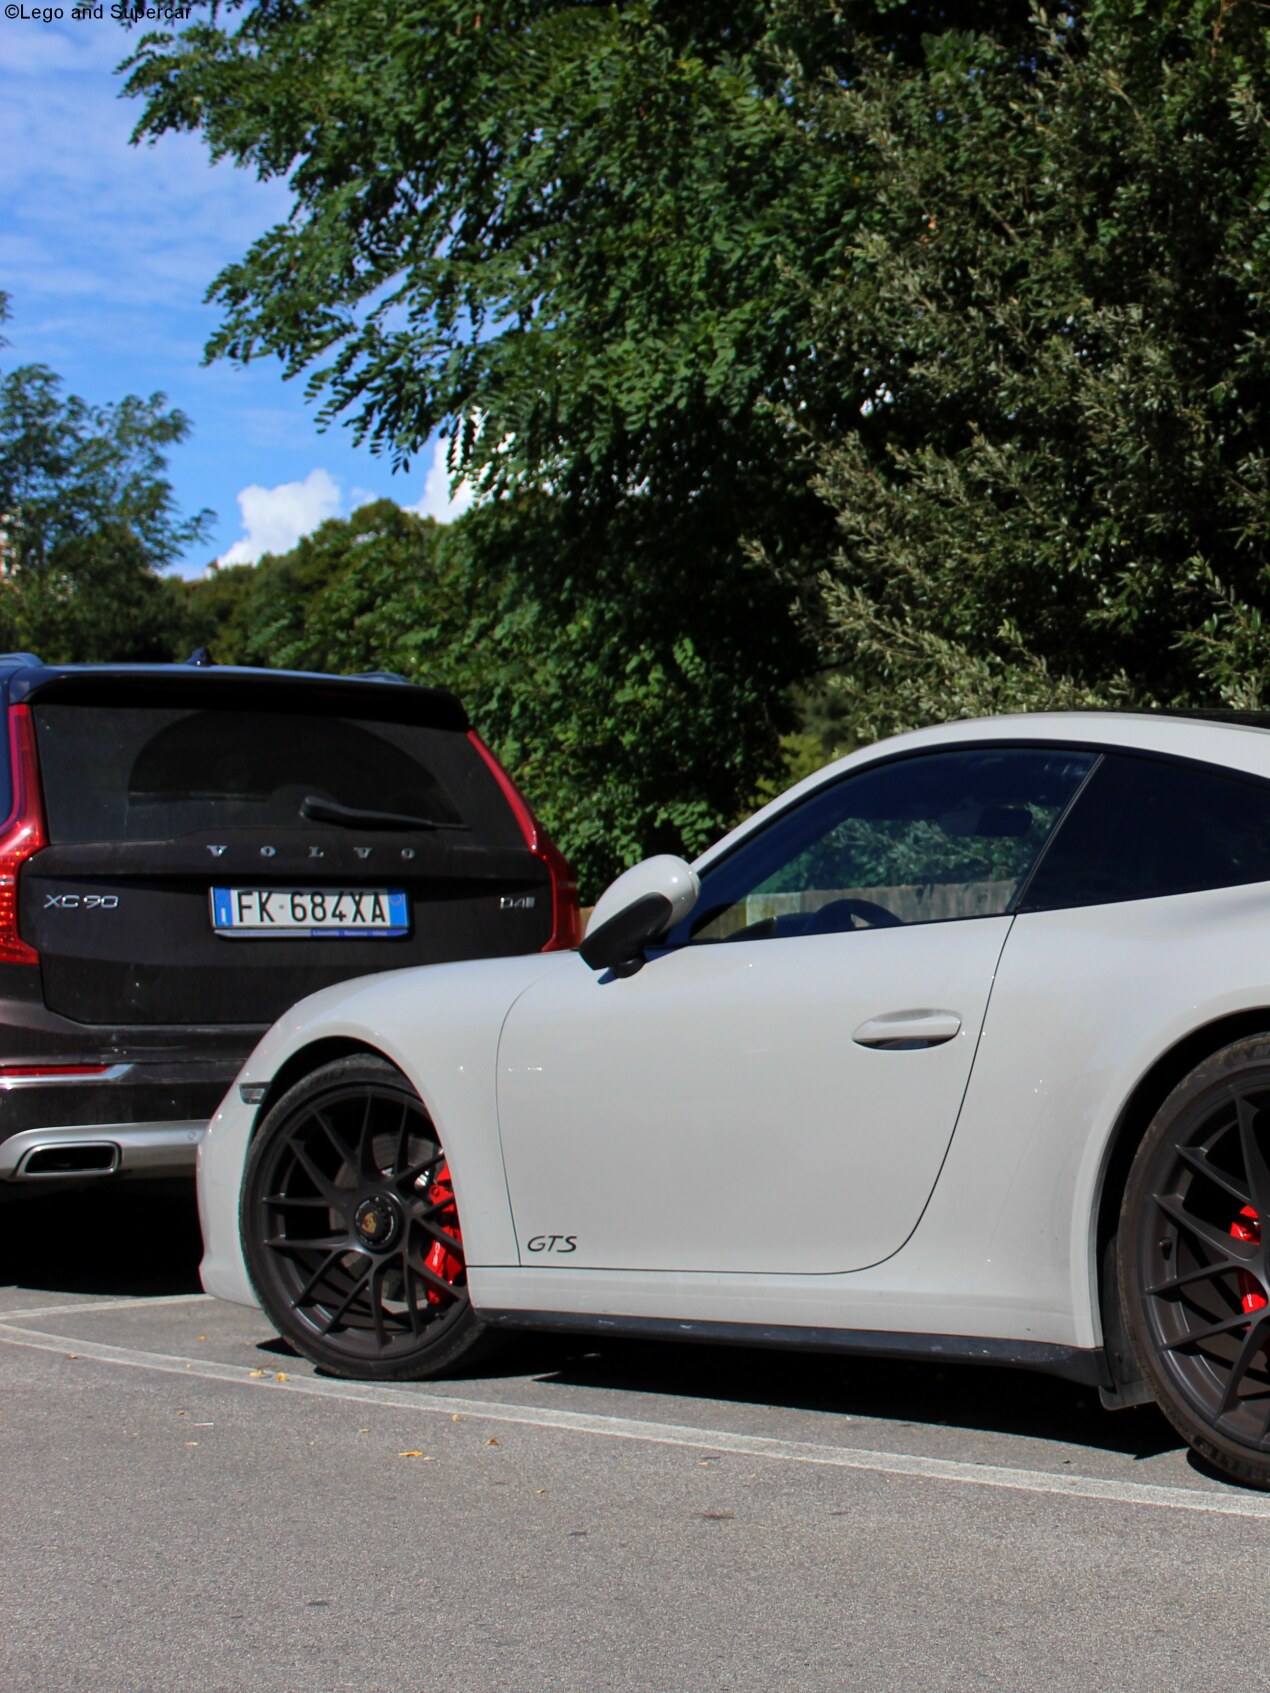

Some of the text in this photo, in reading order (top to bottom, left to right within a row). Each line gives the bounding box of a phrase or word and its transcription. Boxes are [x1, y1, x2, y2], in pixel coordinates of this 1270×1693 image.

[206, 845, 415, 859] VOLVO
[43, 894, 118, 908] XC90
[527, 1235, 577, 1253] GTS
